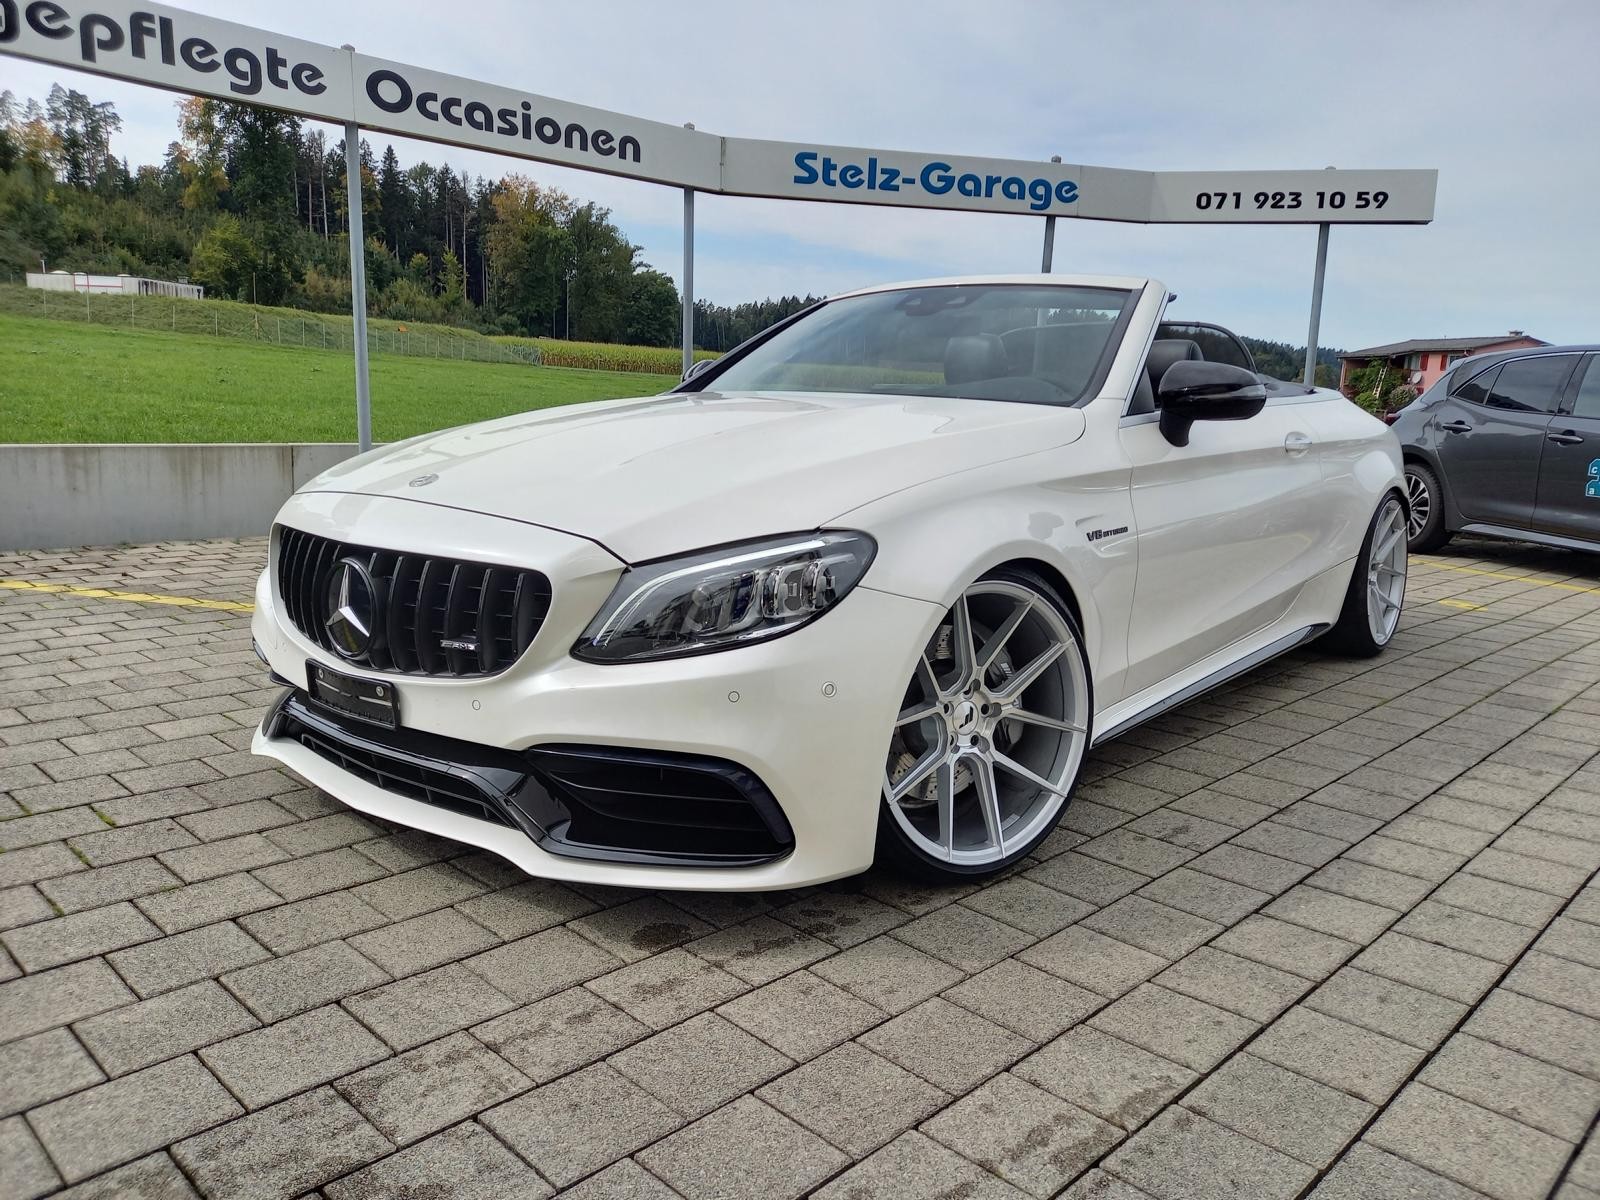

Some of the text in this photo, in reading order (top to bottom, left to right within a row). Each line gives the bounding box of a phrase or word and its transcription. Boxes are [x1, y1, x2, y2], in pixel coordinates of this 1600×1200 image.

[365, 69, 641, 164] Occasionen
[793, 151, 1080, 212] Stelz-Garage
[1195, 190, 1390, 211] 071 923 10 59
